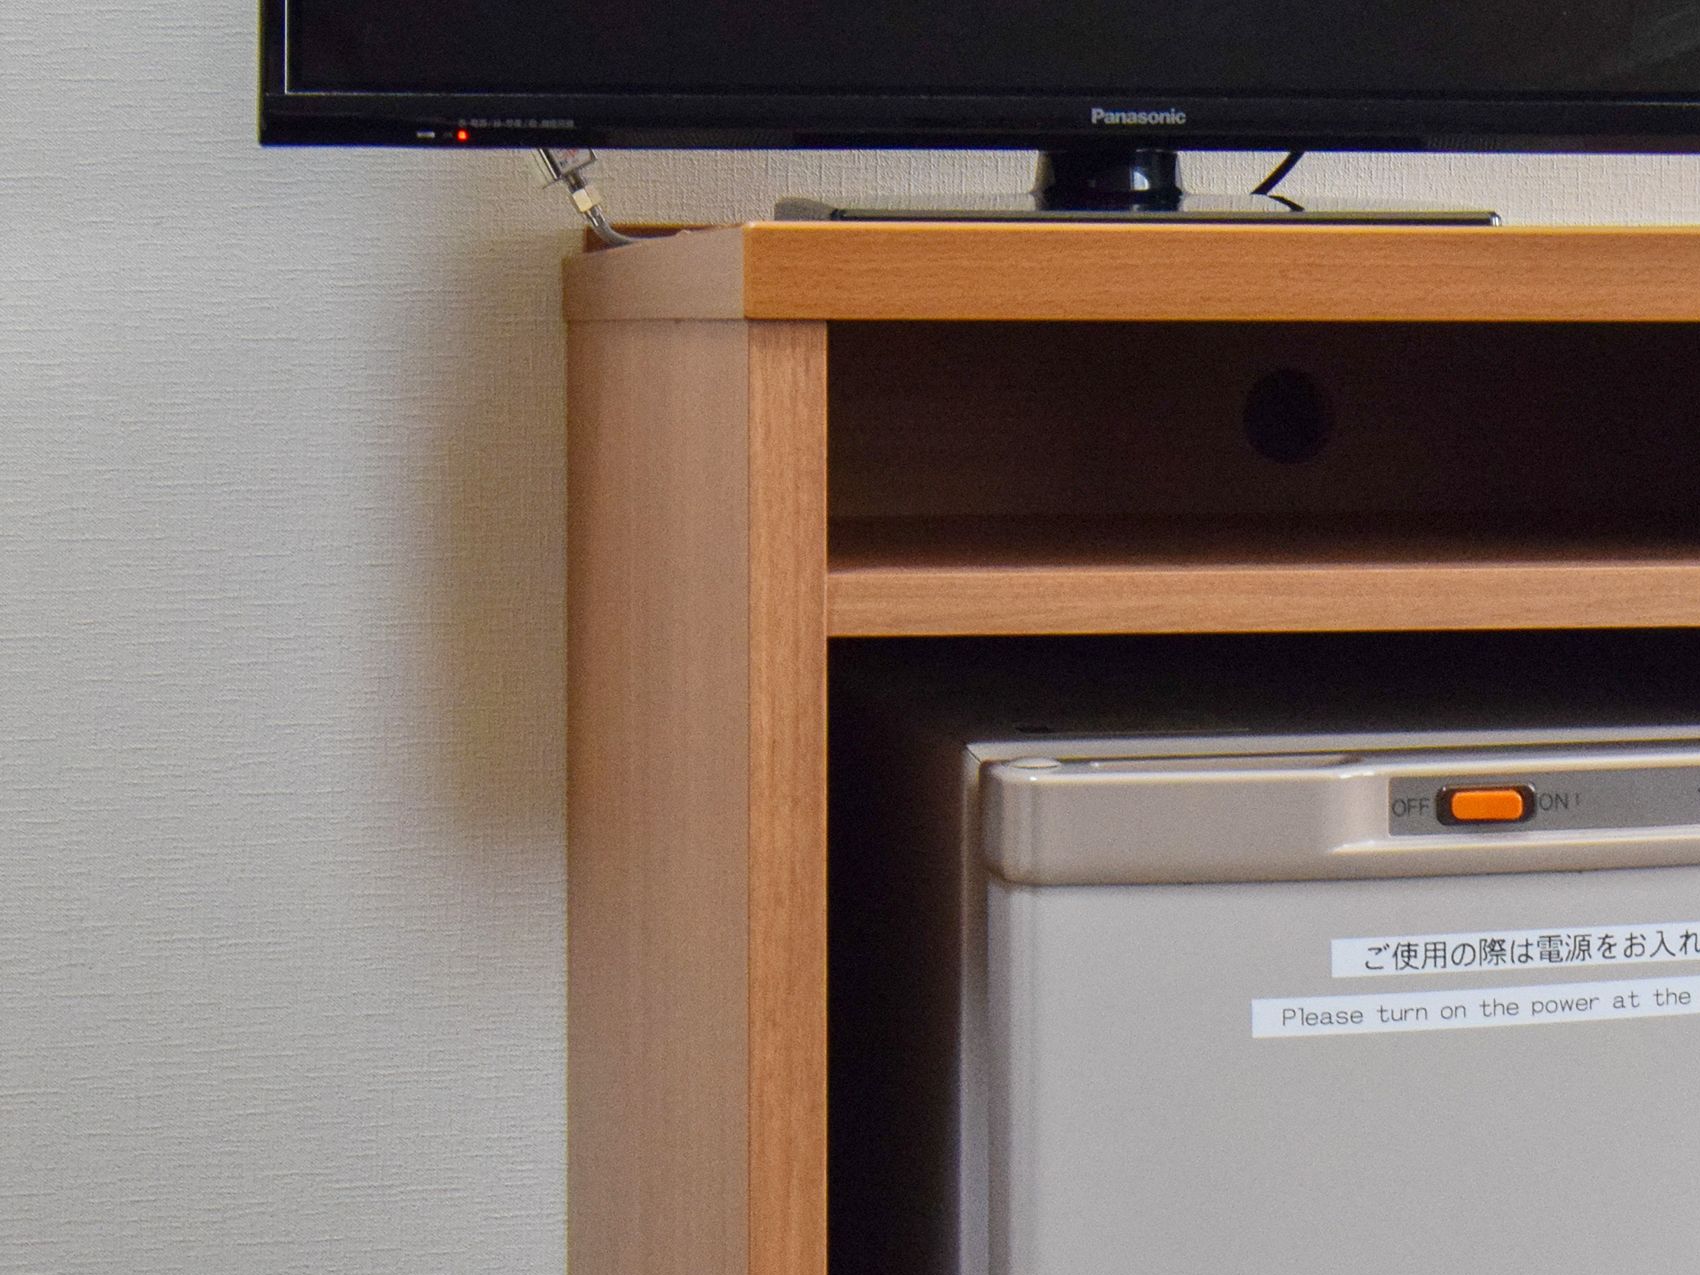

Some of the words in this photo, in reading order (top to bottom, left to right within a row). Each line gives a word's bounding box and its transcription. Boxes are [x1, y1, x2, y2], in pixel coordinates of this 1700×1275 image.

[1091, 108, 1187, 124] Panasonic
[1392, 797, 1430, 817] OFF
[1539, 792, 1569, 811] ON
[1282, 1007, 1364, 1026] Please
[1377, 1004, 1428, 1023] turn
[1440, 1004, 1467, 1020] on
[1479, 998, 1520, 1017] the
[1531, 996, 1600, 1016] power
[1612, 991, 1641, 1009] at
[1653, 987, 1692, 1007] the
